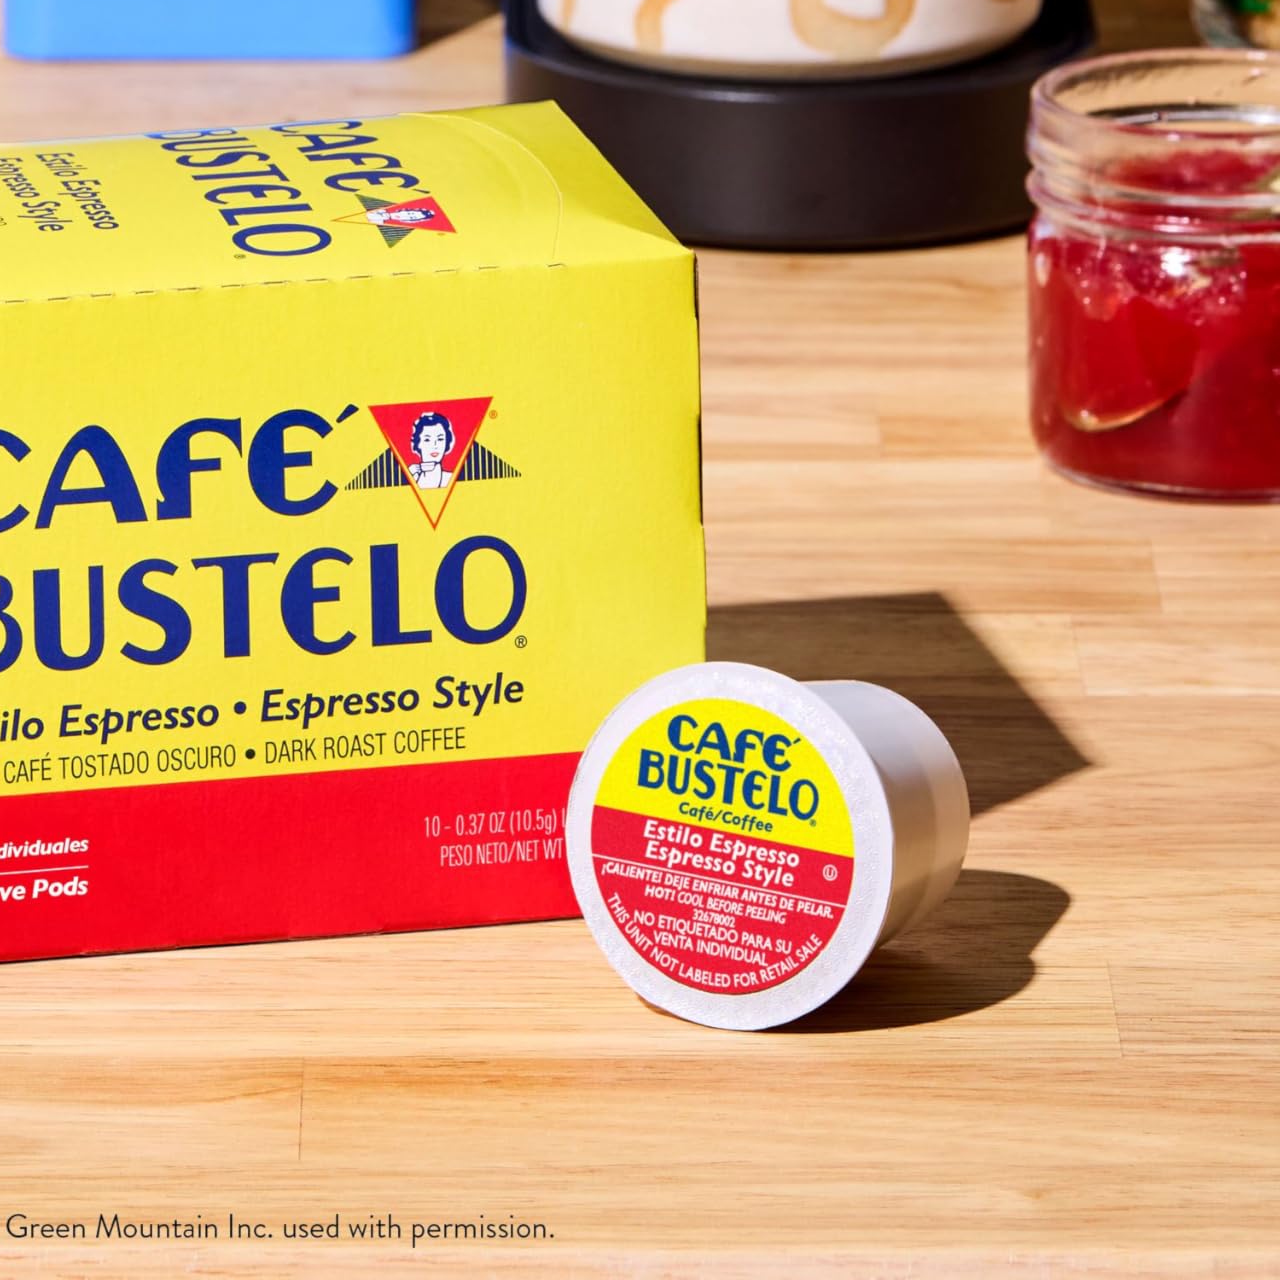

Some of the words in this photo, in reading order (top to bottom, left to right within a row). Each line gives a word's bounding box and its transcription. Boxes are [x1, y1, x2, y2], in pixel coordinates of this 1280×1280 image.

[36, 153, 88, 177] Estilo
[269, 120, 430, 194] CAFÉ
[57, 179, 119, 230] Espresso
[144, 127, 332, 257] BUSTELO
[17, 201, 73, 232] Style
[59, 704, 220, 745] Espresso
[261, 688, 420, 730] Espresso
[433, 672, 525, 717] Style
[3, 752, 52, 784] CAFÉ
[58, 751, 150, 779] TOSTADO
[157, 744, 236, 772] OSCURO
[265, 738, 317, 764] DARK
[323, 732, 387, 760] ROAST
[393, 726, 466, 754] COFFEE
[667, 714, 801, 772] CAFÉ
[637, 748, 820, 821] BUSTELO
[424, 816, 441, 838] 10
[455, 812, 485, 836] 0.37
[489, 811, 505, 834] OZ
[509, 808, 557, 837] (10.5g)
[678, 801, 774, 833] Café/Coffee
[440, 844, 473, 867] PESO
[476, 839, 540, 865] NETO/NET
[543, 837, 564, 860] WT
[643, 819, 703, 848] Estilo
[710, 833, 800, 868] Espresso
[645, 840, 736, 875] Espresso
[742, 859, 795, 888] Style
[32, 876, 89, 899] Pods
[600, 861, 663, 884] ¡CALIENTE!
[664, 873, 691, 890] DEJE
[692, 879, 740, 899] ENFRIAR
[741, 891, 777, 908] ANTES
[779, 898, 795, 911] DE
[797, 901, 834, 919] PELAR.
[644, 884, 677, 901] HOT!
[677, 891, 705, 908] COOL
[706, 897, 744, 916] BEFORE
[745, 905, 787, 925] PEELING
[608, 891, 631, 924] THIS
[624, 920, 654, 951] UNIT
[649, 946, 680, 972] NOT
[678, 962, 731, 988] LABELED
[733, 974, 759, 988] FOR
[759, 957, 800, 983] RETAIL
[795, 933, 823, 962] SALE
[633, 908, 655, 927] NO
[657, 914, 739, 944] ETIQUETADO
[741, 932, 771, 951] PARA
[775, 939, 793, 954] SU
[653, 930, 694, 951] VENTA
[696, 938, 769, 967] INDIVIDUAL
